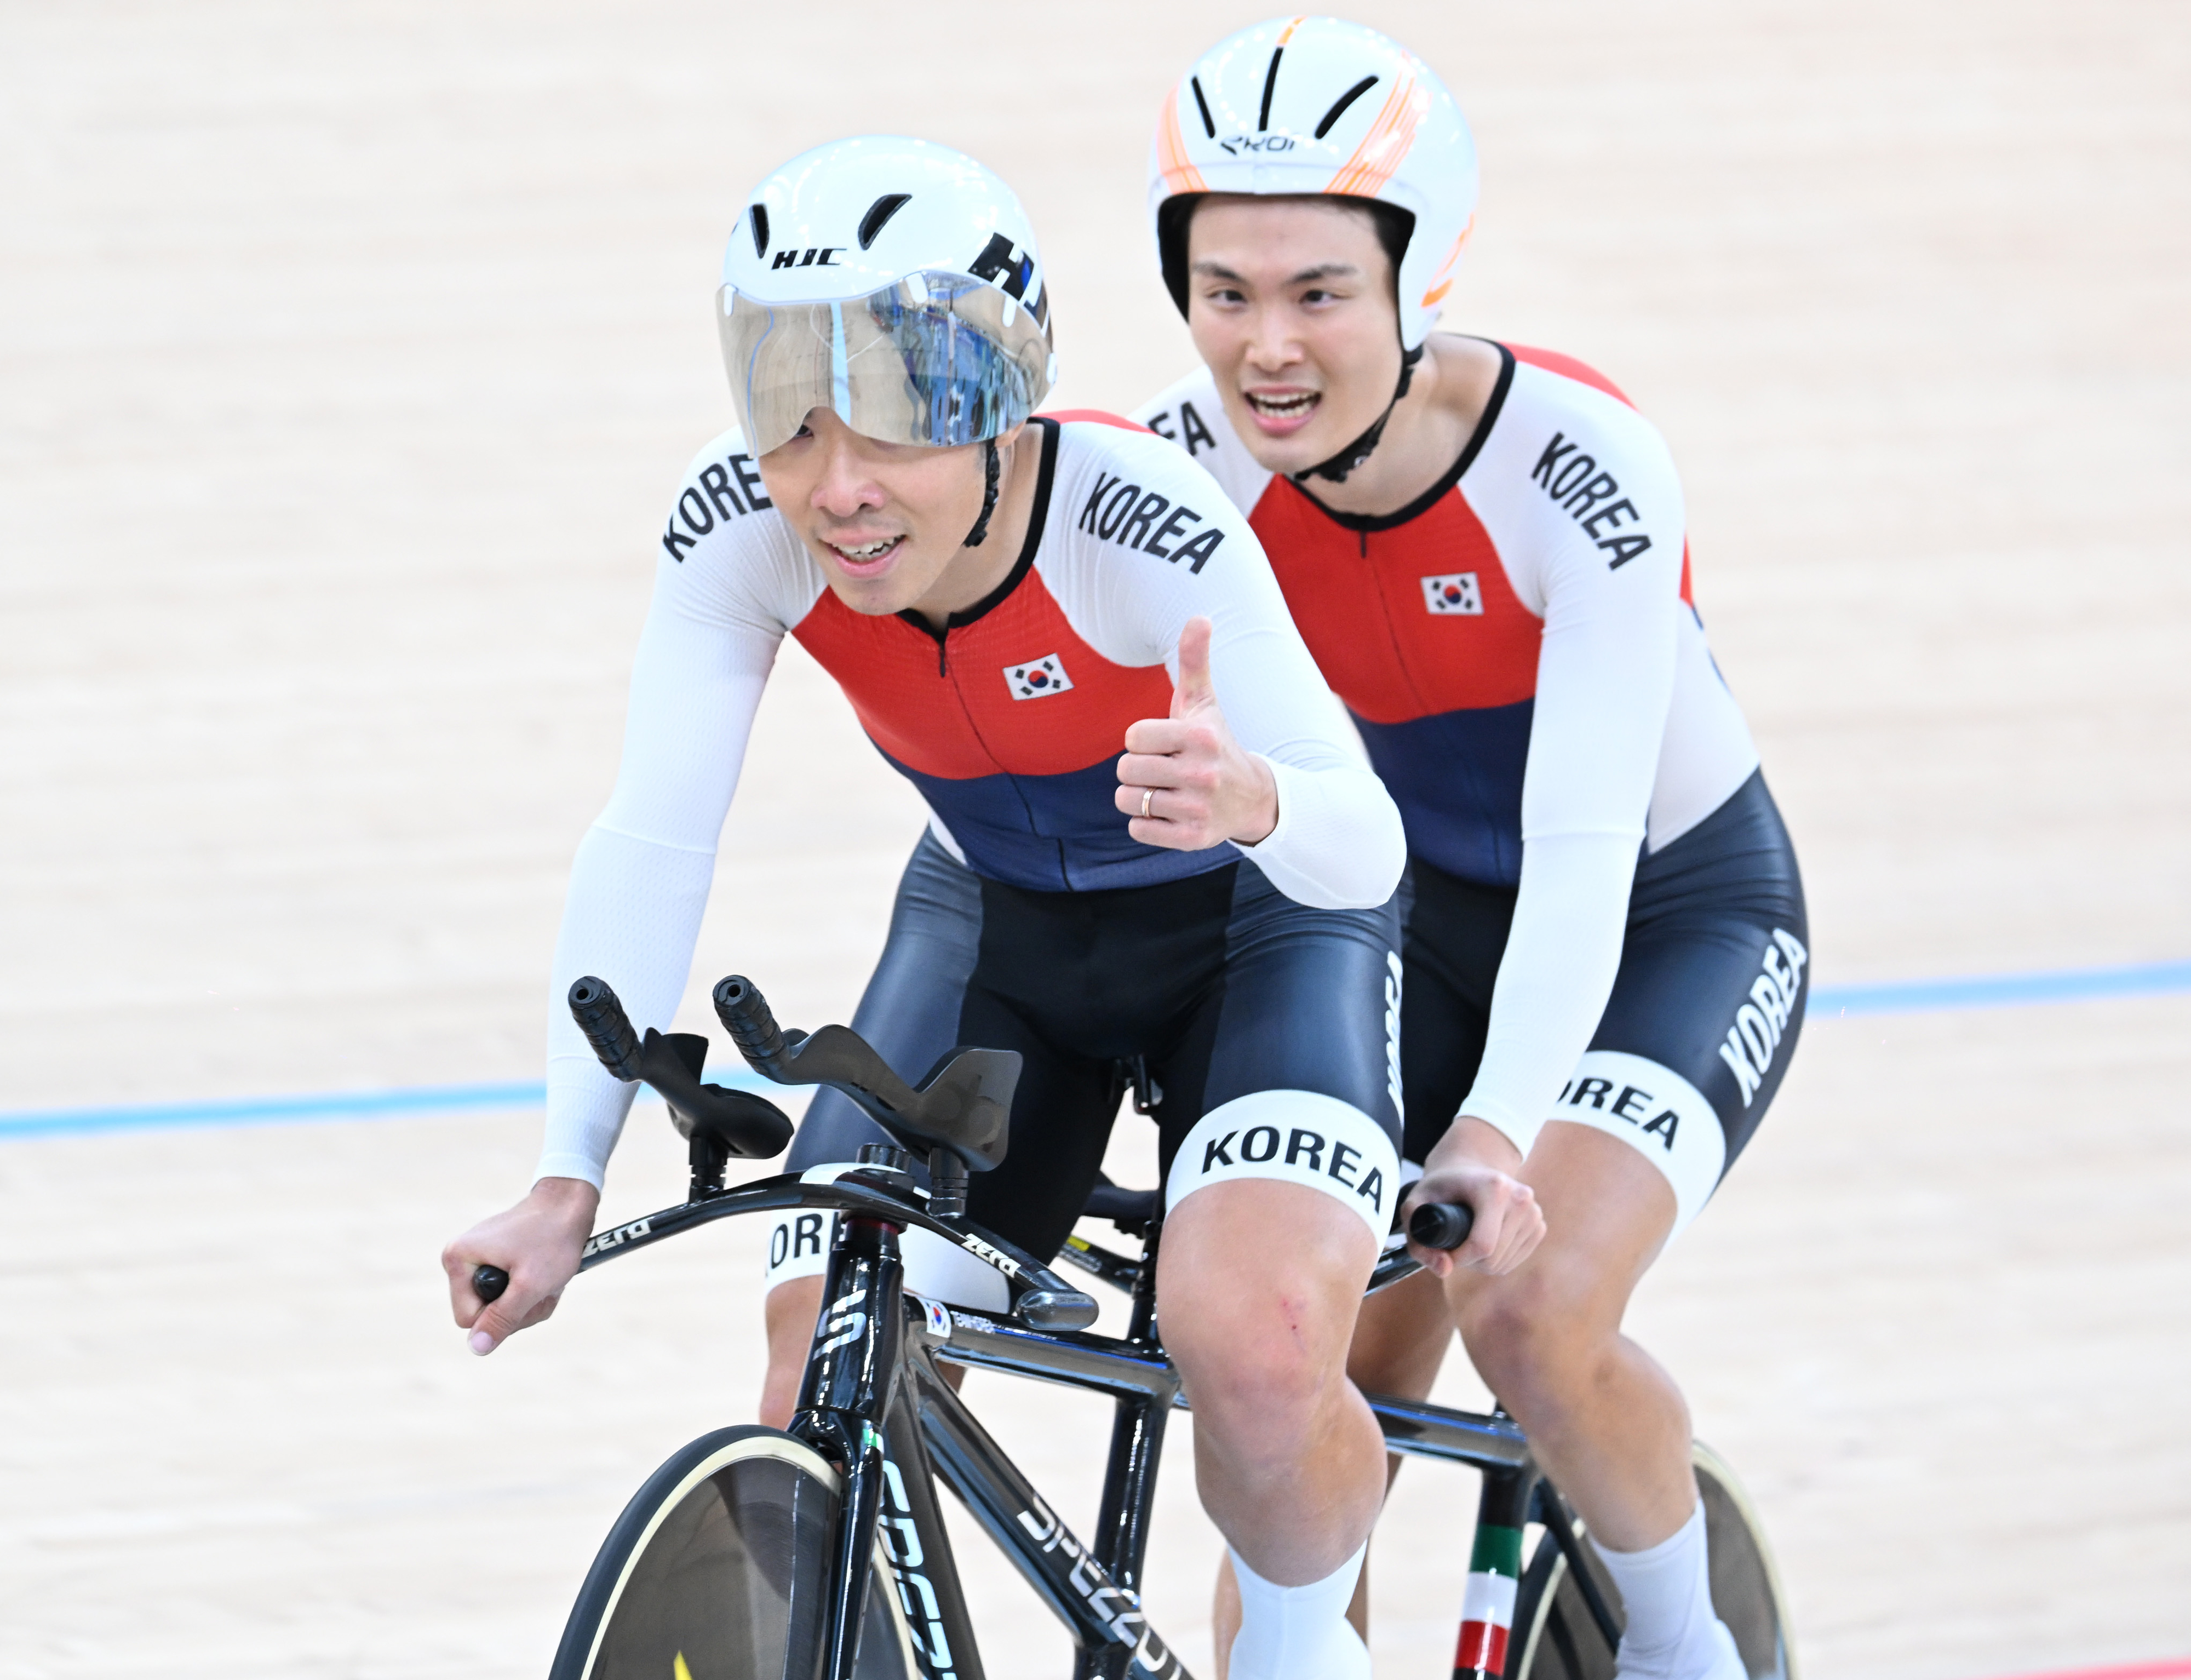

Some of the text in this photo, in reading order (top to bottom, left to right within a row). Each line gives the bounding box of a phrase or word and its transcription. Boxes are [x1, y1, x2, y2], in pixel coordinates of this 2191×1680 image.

[771, 248, 847, 270] HJC
[1079, 472, 1226, 575] KOREA
[1531, 431, 1653, 571] KOREA
[1718, 927, 1808, 1109] KOREA
[1557, 1076, 1680, 1152] REA
[1202, 1126, 1383, 1215] KOREA
